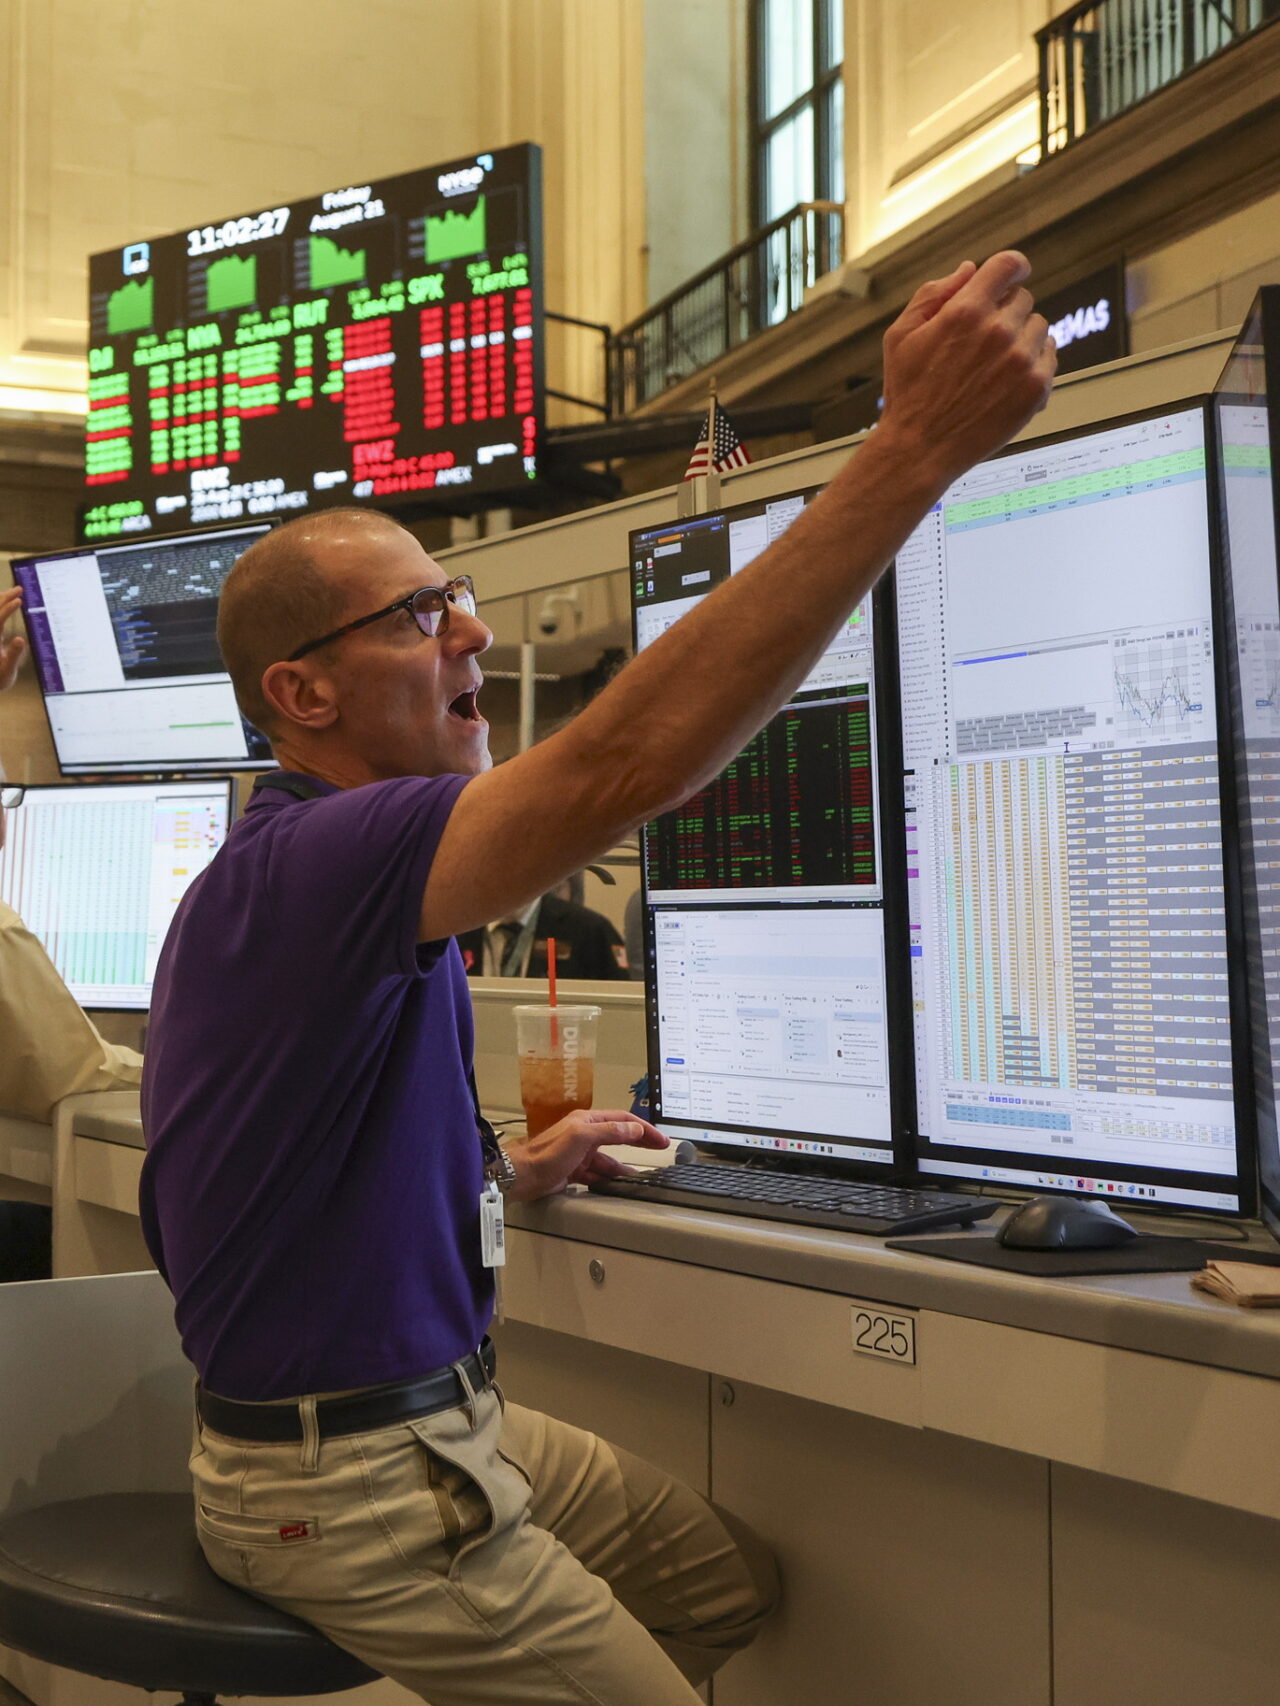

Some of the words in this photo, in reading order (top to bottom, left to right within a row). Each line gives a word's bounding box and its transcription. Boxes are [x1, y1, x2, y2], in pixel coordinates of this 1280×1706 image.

[322, 186, 372, 211] Friday
[309, 205, 363, 232] August
[364, 199, 385, 219] 21
[187, 207, 290, 256] 11:02:27
[407, 273, 445, 304] SPX
[293, 298, 329, 329] RUT
[352, 439, 396, 466] EWZ
[435, 465, 472, 487] AMEX
[856, 1313, 908, 1357] 225
